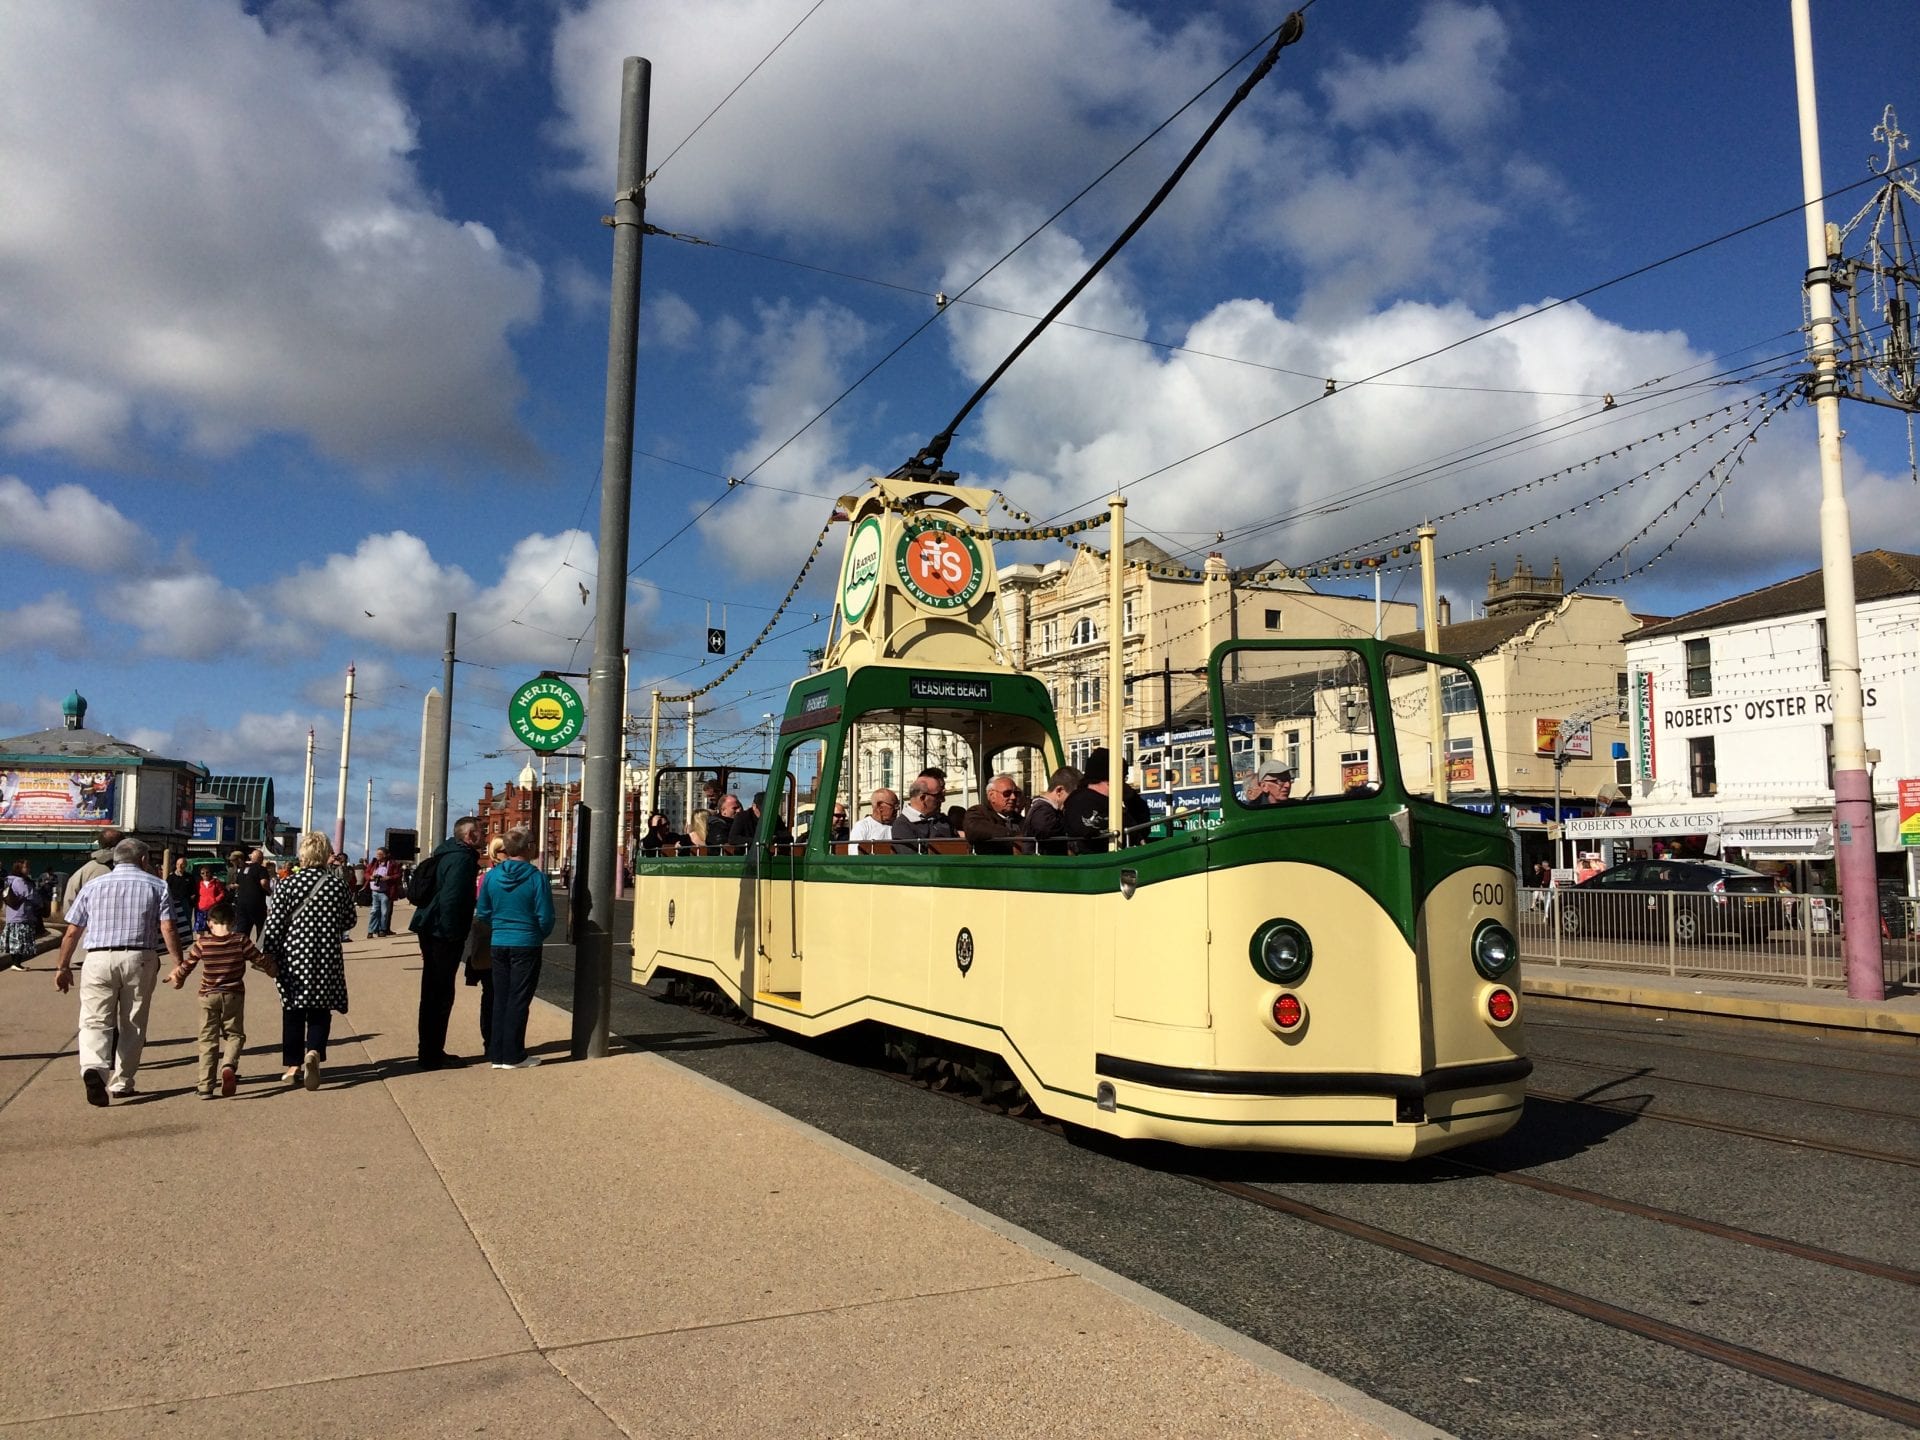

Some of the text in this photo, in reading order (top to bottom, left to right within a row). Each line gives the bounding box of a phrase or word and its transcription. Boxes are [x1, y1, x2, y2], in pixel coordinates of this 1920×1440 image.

[896, 558, 982, 606] TRAMWAY SOCIETY
[517, 684, 576, 709] HERITAGE
[911, 679, 987, 698] PLEASURE BEACH
[1664, 704, 1738, 729] ROBERTS'
[1744, 696, 1806, 720] OYSTER
[516, 717, 576, 744] TRAM STOP
[1570, 819, 1627, 831] ROBERTS'
[1631, 817, 1666, 829] ROCK
[1669, 818, 1679, 827] &
[1684, 815, 1714, 827] ICES
[1738, 827, 1802, 840] SHELLFISH
[1472, 883, 1504, 905] 600
